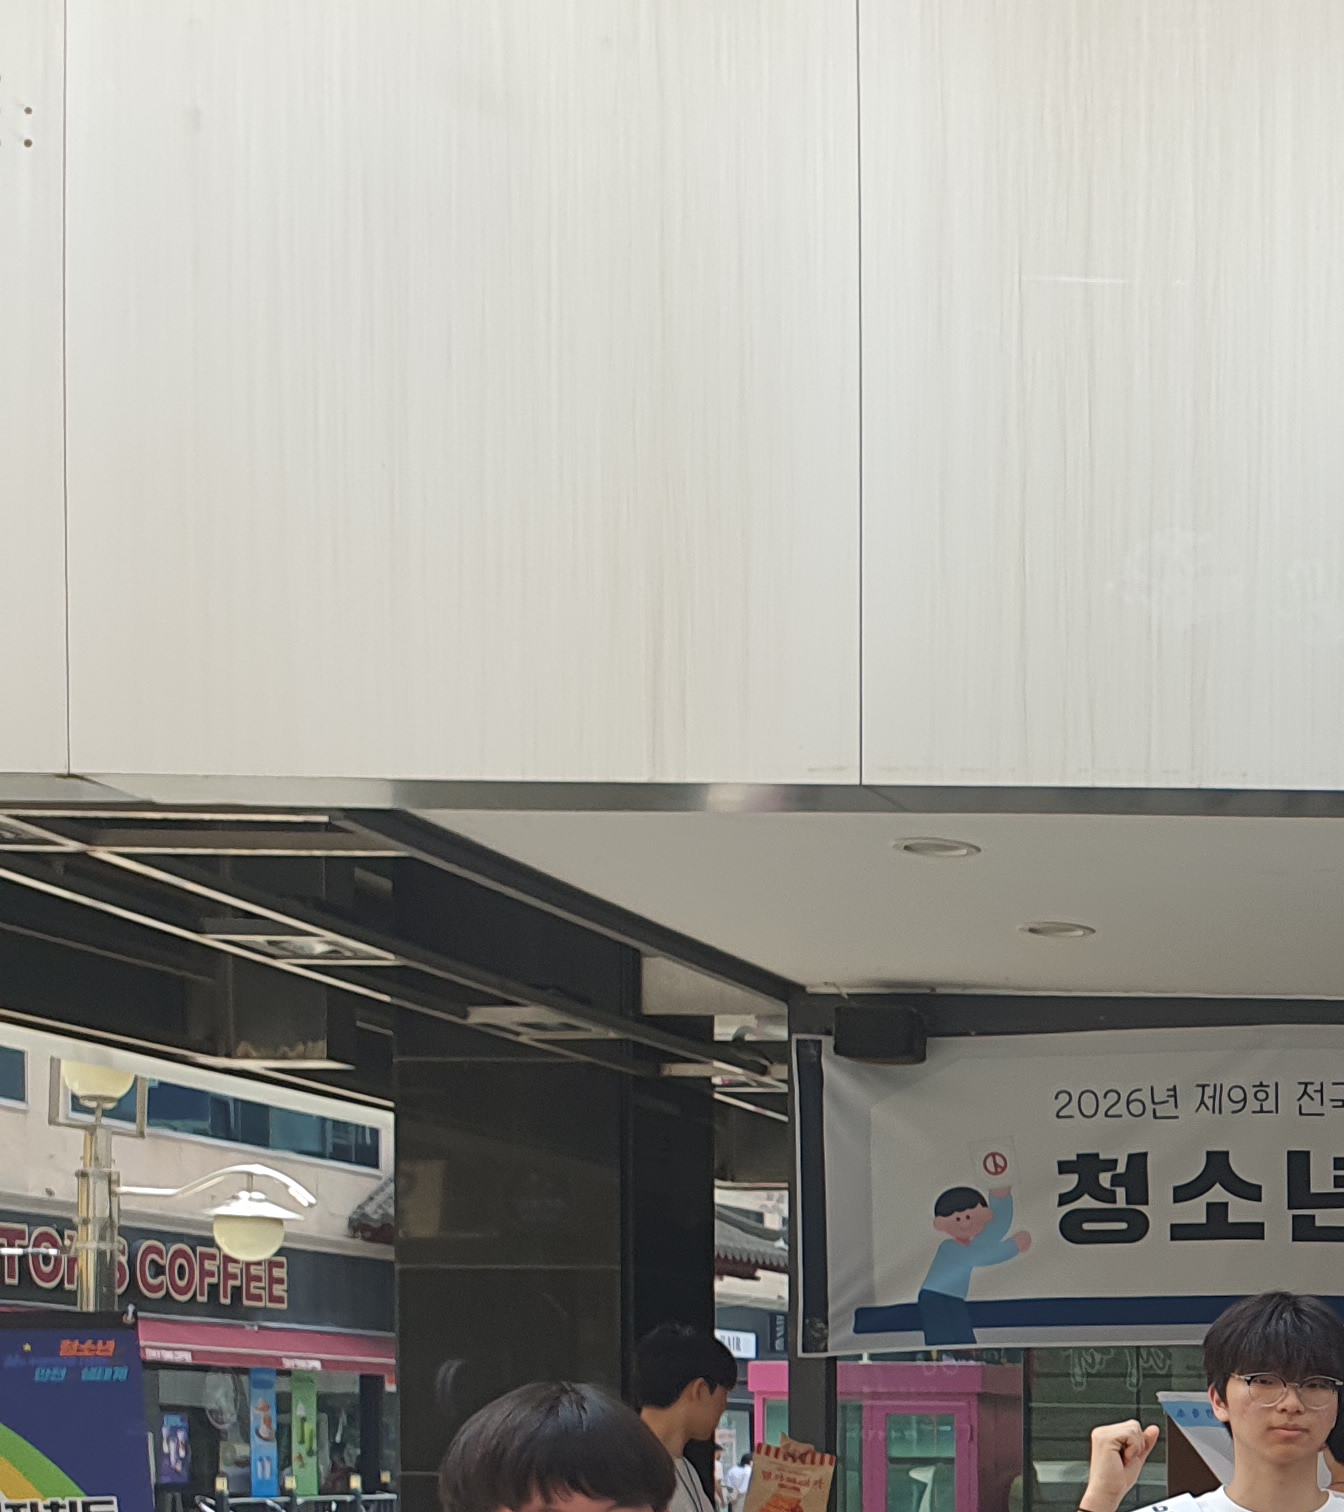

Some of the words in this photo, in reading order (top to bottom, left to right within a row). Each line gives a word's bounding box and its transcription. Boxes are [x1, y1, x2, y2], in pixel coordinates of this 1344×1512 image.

[1053, 1081, 1181, 1122] 2026년
[1195, 1080, 1281, 1118] 제9회
[137, 1239, 289, 1310] COFFEE
